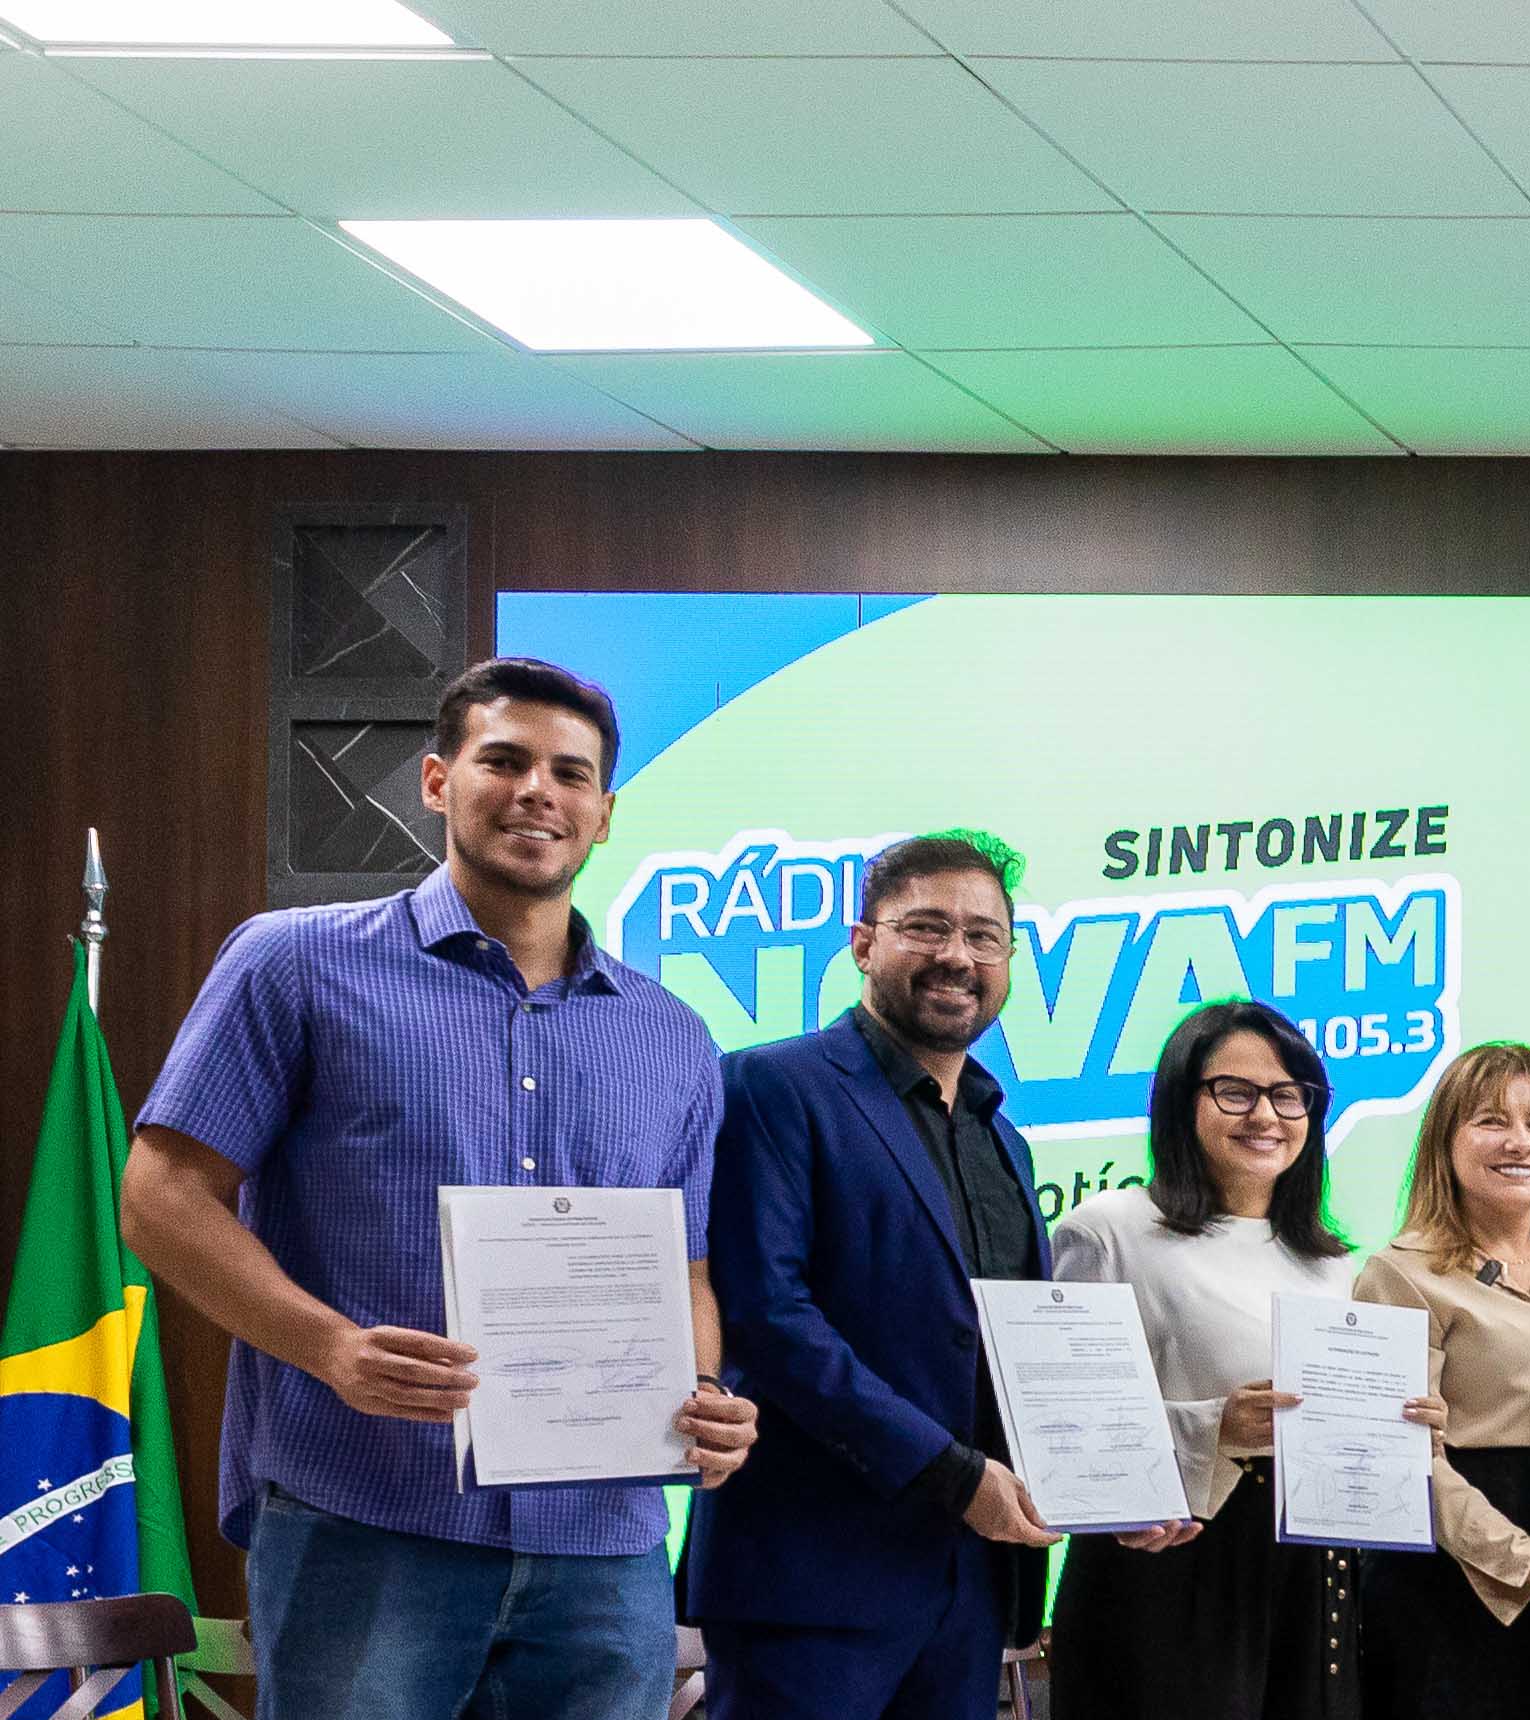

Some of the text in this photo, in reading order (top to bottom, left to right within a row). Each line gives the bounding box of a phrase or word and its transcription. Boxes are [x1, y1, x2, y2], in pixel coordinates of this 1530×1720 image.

[1103, 806, 1450, 881] SINTONIZE
[660, 852, 857, 940] RÁDI
[1272, 896, 1438, 998] FM
[660, 913, 1254, 1083] NVA
[1299, 1009, 1437, 1060] 105.3
[13, 1461, 134, 1534] PROGRESS
